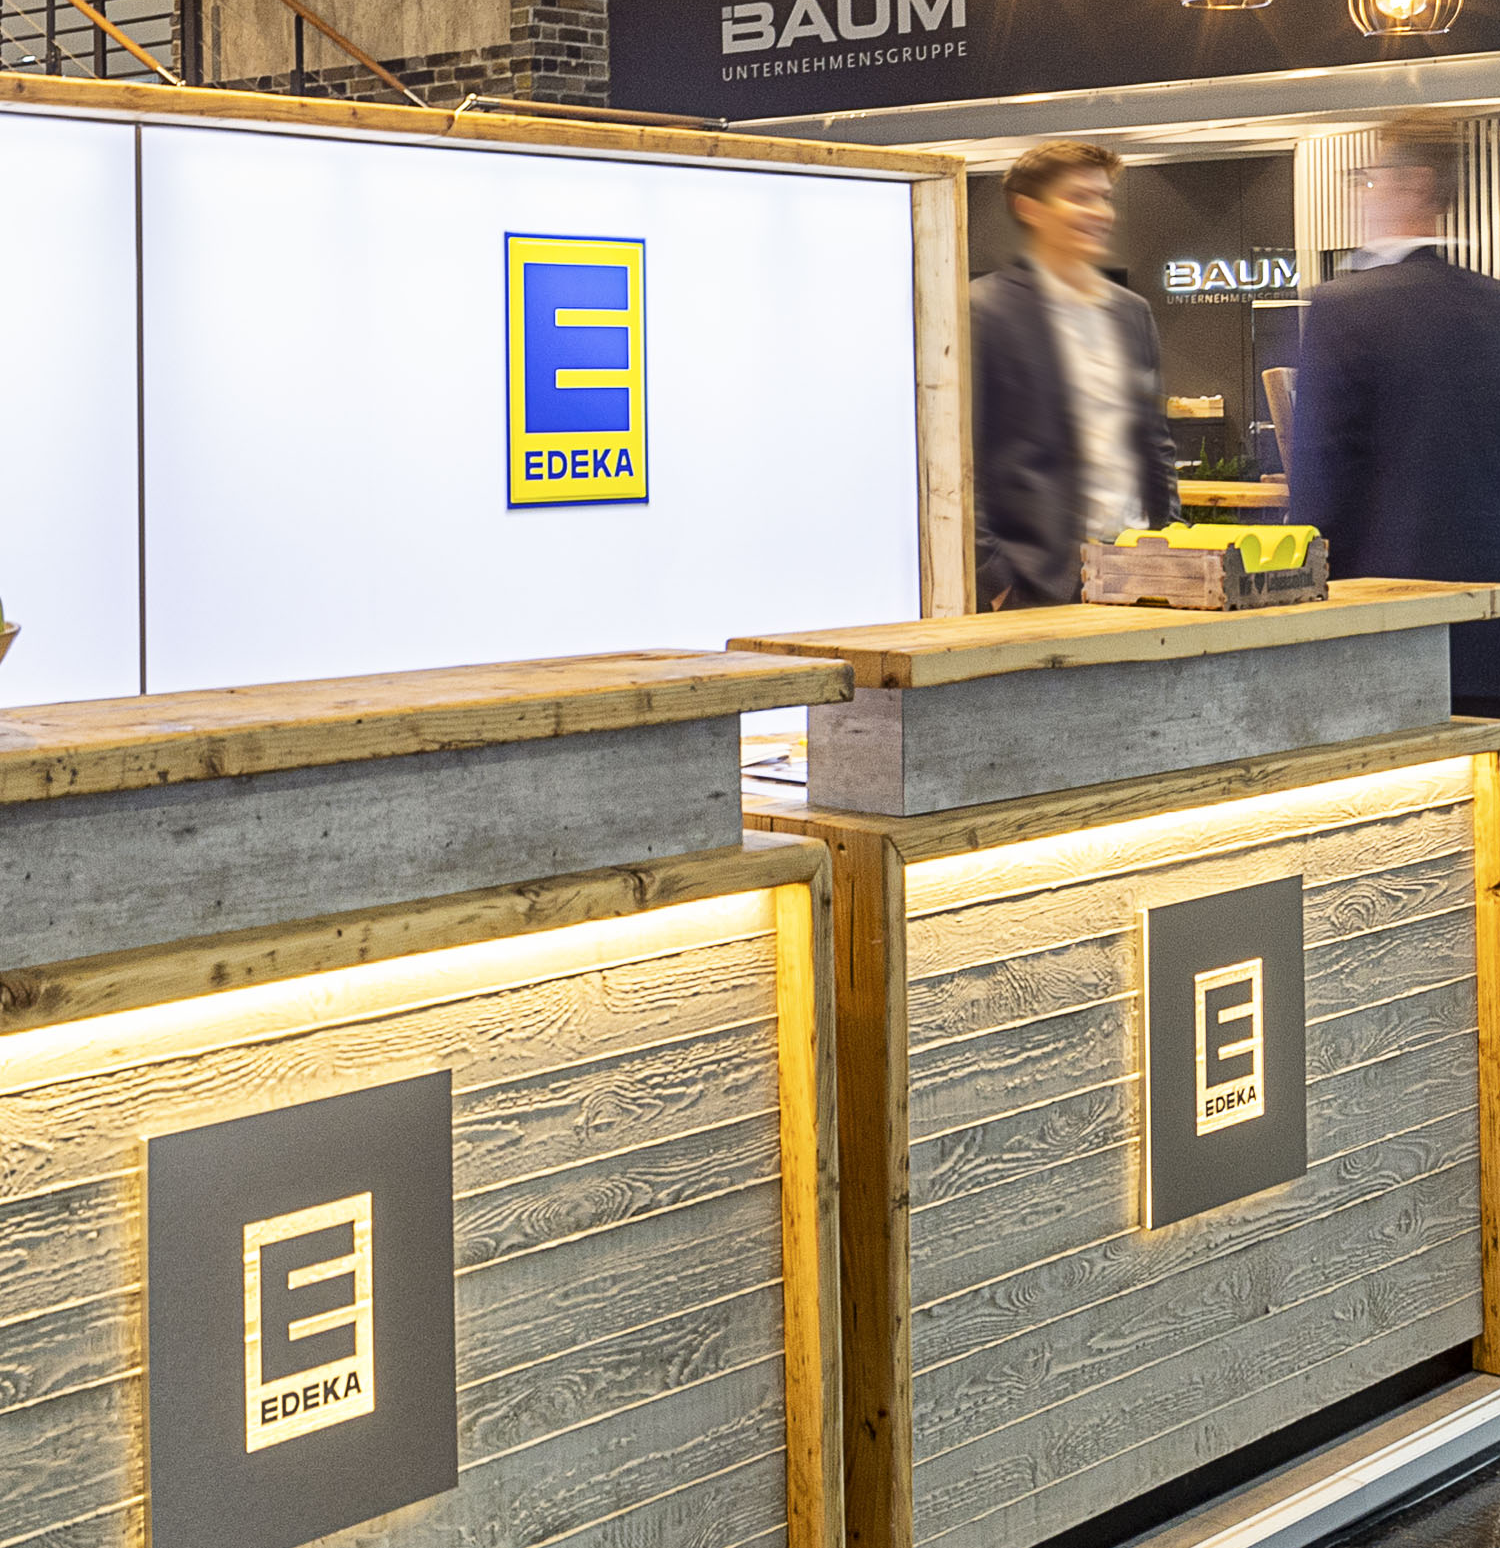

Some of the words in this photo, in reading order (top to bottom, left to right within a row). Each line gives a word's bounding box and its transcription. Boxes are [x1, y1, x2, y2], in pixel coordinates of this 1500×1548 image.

[722, 41, 968, 82] UNTERNEHMENSGRUPPE
[524, 448, 634, 481] EDEKA
[1205, 1085, 1257, 1118] EDEKA
[260, 1371, 362, 1426] EDEKA
